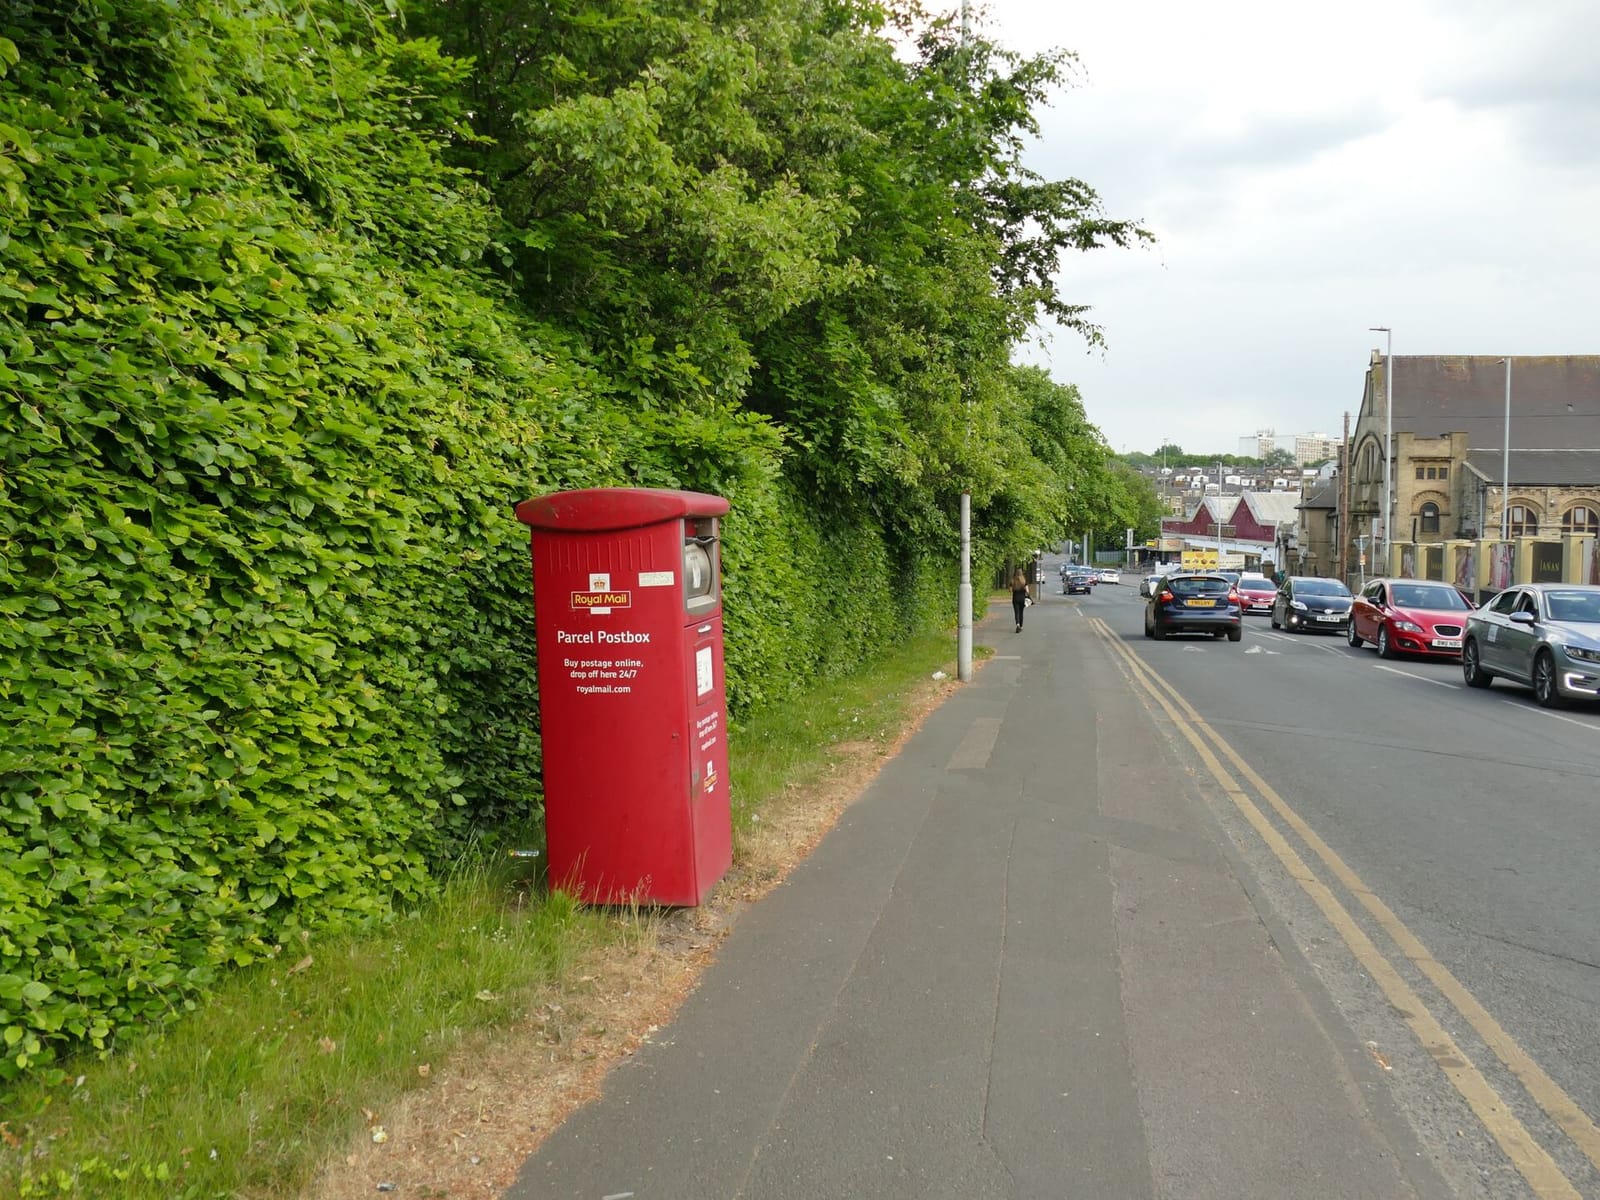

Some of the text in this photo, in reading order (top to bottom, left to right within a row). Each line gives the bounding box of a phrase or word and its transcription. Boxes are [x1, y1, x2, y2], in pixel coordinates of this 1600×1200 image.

[575, 594, 627, 605] Royal Mail
[557, 630, 650, 643] Parcel Postbox
[564, 658, 579, 668] Buy
[580, 659, 612, 669] postage
[570, 669, 637, 679] drop off here 24/7
[576, 685, 631, 694] royalmail.com
